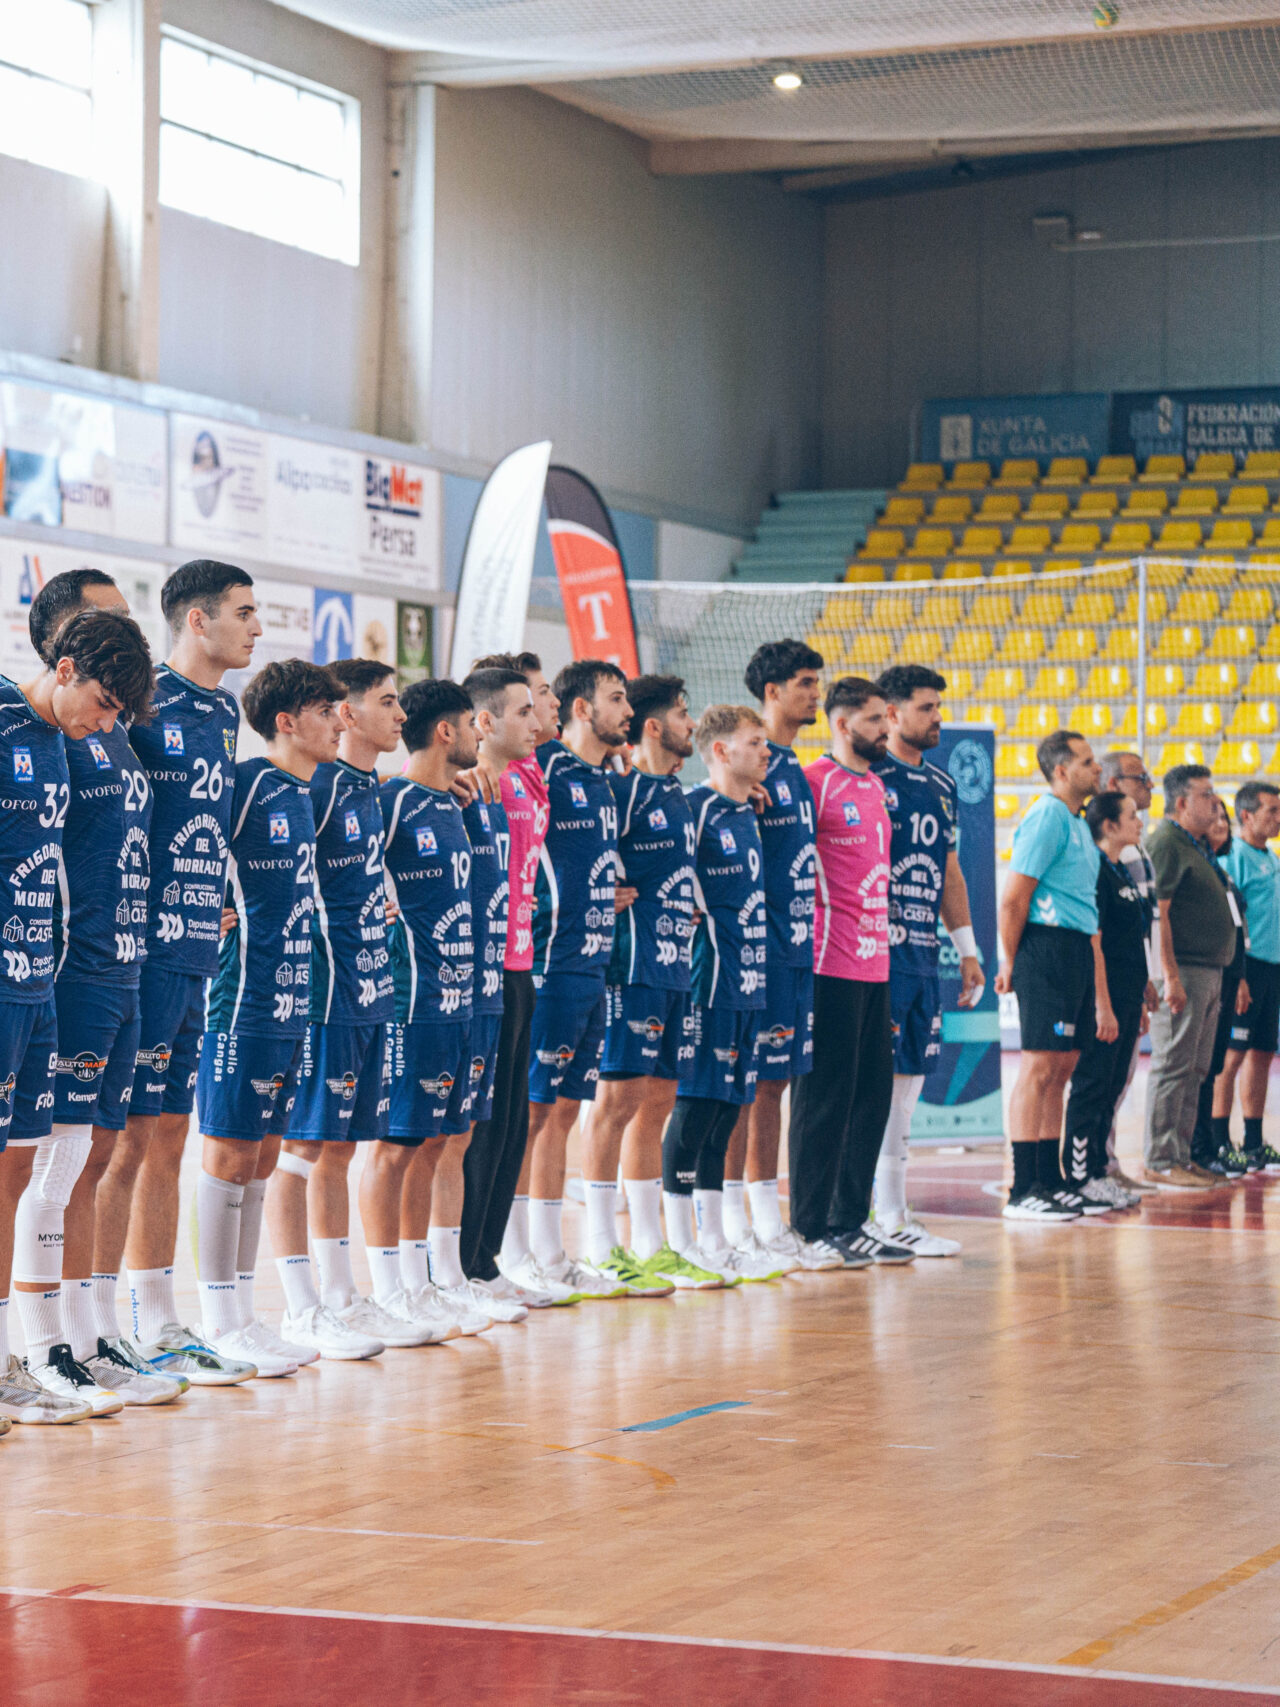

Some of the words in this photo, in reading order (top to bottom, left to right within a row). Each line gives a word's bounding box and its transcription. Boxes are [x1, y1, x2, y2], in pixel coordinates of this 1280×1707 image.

[150, 691, 187, 713] ITALDENT
[80, 784, 122, 800] WOFCO
[121, 769, 149, 813] 29
[190, 757, 223, 802] 26
[39, 783, 70, 829] 32
[799, 800, 814, 834] 4
[556, 819, 595, 831] WOFCO
[599, 806, 618, 841] 14
[876, 821, 884, 854] 1
[909, 812, 939, 847] 10
[195, 837, 210, 853] DEL
[495, 833, 510, 871] 17
[248, 858, 294, 870] WOFCO
[397, 868, 443, 882] WOFCO
[451, 851, 470, 889] 19
[748, 848, 760, 882] 9
[183, 891, 221, 908] CASTRO
